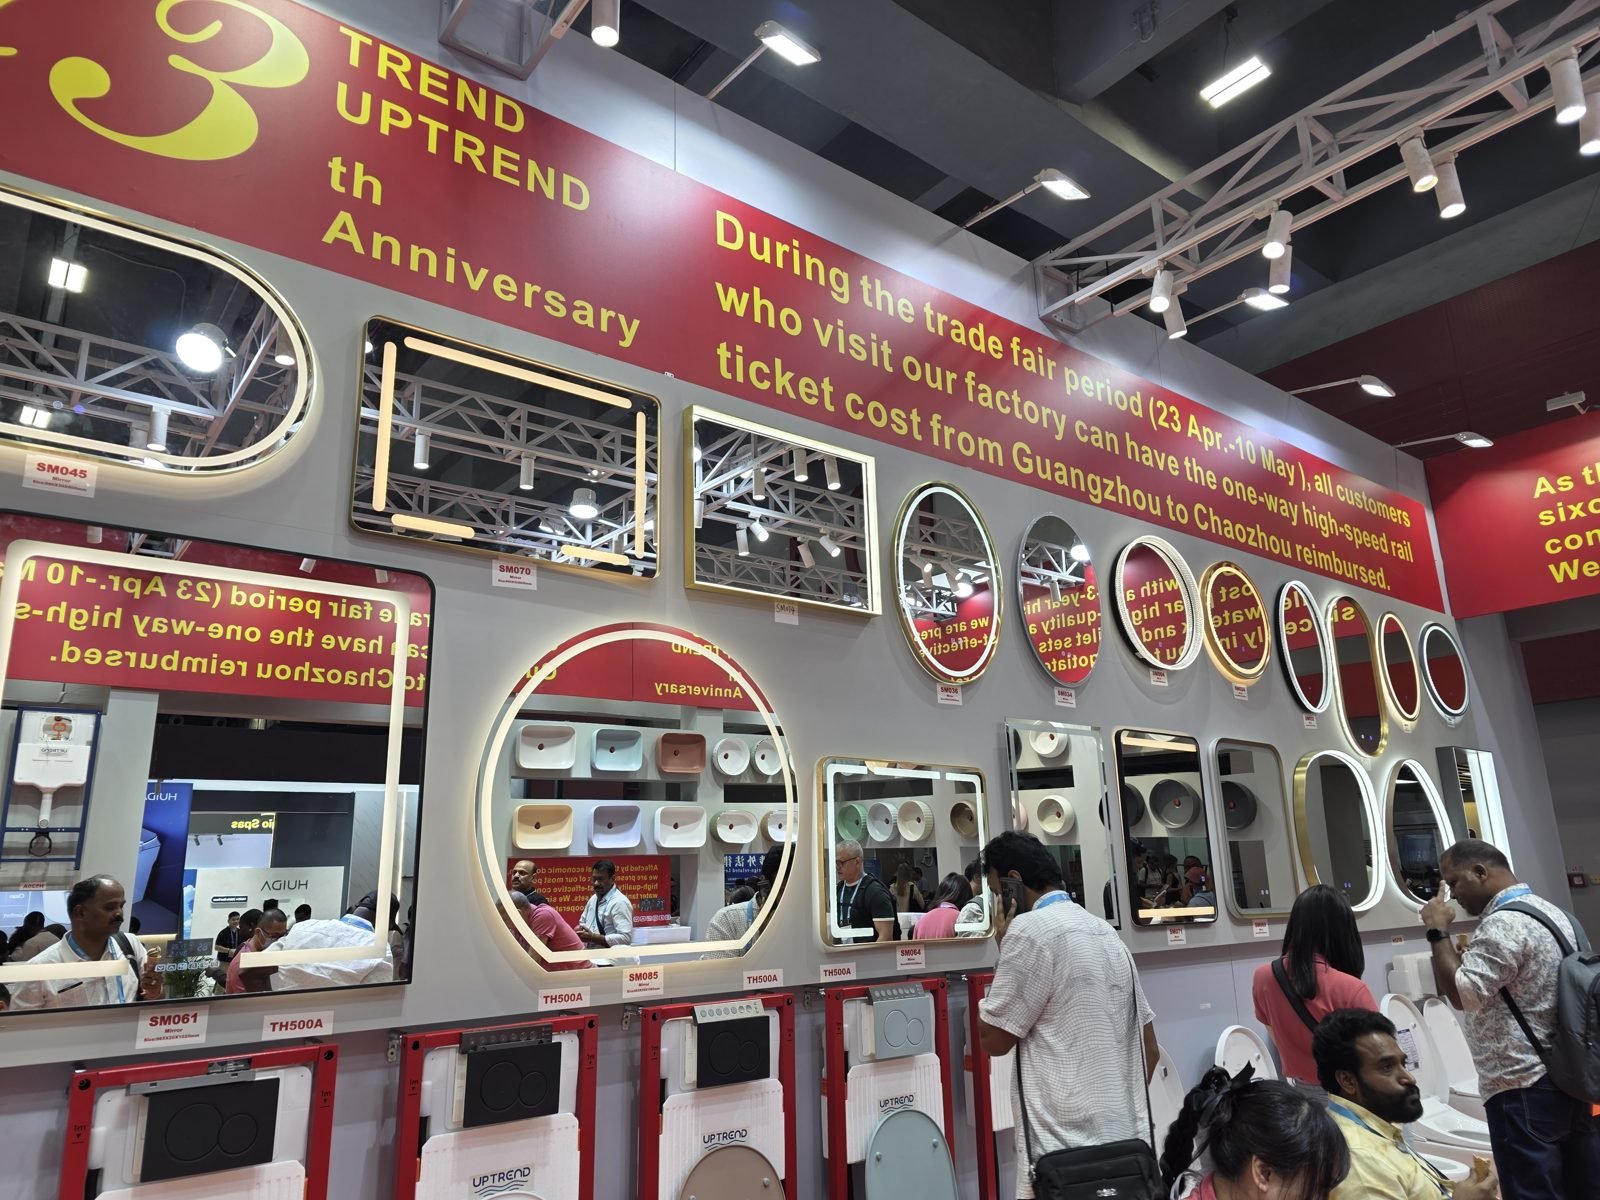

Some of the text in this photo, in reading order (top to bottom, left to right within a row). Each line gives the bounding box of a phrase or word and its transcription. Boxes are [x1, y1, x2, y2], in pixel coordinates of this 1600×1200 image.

[0, 0, 312, 161] 3
[338, 27, 525, 133] TREND
[335, 80, 590, 211] UPTREND
[327, 155, 383, 206] th
[321, 210, 640, 348] Anniversary
[715, 210, 851, 305] During
[860, 275, 914, 324] the
[924, 303, 1004, 360] trade
[1010, 336, 1056, 378] fair
[1064, 366, 1144, 418] period
[1149, 397, 1182, 433] (23
[1261, 446, 1295, 487] May
[1314, 473, 1334, 497] all
[1336, 484, 1411, 528] customers
[715, 281, 1414, 562] who visit our factory can have the one-way high-speed rail
[36, 462, 88, 479] SM045
[716, 341, 1391, 591] ticket cost from Guangzhou to Chaozhou reimbursed.
[1533, 474, 1575, 500] As
[498, 564, 531, 575] SM070
[1548, 559, 1600, 584] We
[900, 948, 921, 957] SM064
[628, 971, 658, 982] SM085
[747, 974, 778, 984] TH500A
[823, 967, 852, 977] TH500A
[543, 992, 583, 1005] TH500A
[149, 1012, 198, 1027] SM061
[270, 1018, 323, 1033] TH500A
[879, 1094, 914, 1109] UPTREND
[703, 1128, 748, 1144] UPTREND
[472, 1166, 531, 1188] UPTREND
